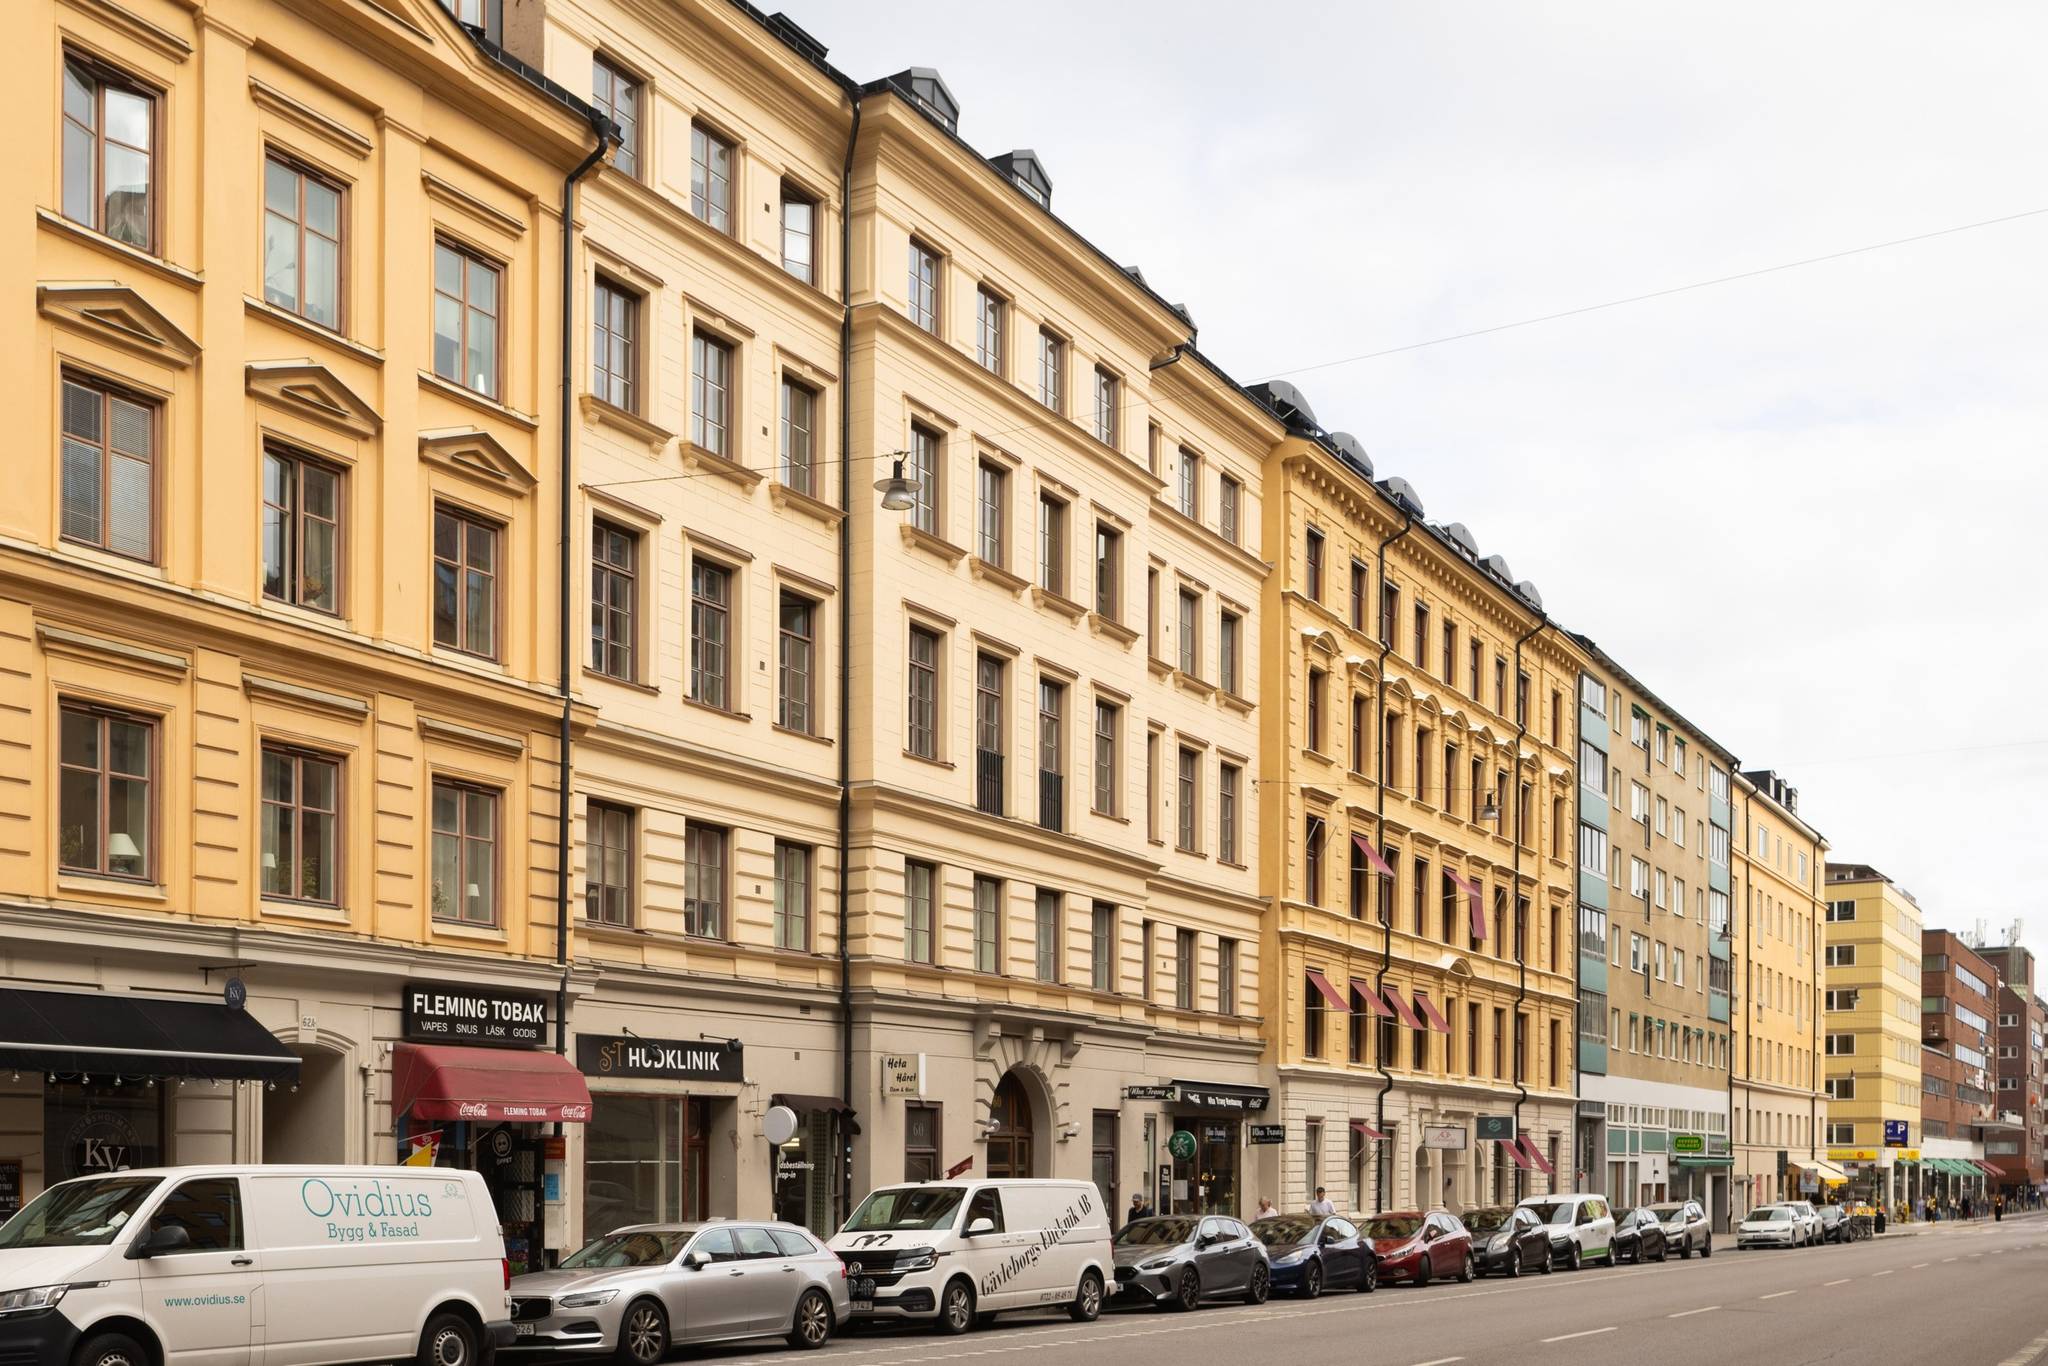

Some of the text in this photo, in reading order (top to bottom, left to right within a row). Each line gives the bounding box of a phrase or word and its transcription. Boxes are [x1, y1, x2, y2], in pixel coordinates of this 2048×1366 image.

[413, 993, 544, 1023] FLEMING TOBAK
[421, 1021, 537, 1038] VAPES SNUS LÄSK GODIS
[887, 1058, 907, 1069] Heta
[896, 1072, 917, 1083] Håret
[503, 1107, 547, 1116] FLEMING TOBAK
[302, 1178, 432, 1217] Ovidius
[327, 1222, 419, 1241] Bygg & Fasad
[981, 1242, 1041, 1297] Gävleborgs
[1078, 1193, 1092, 1216] AB
[164, 1294, 246, 1307] www.ovidius.se
